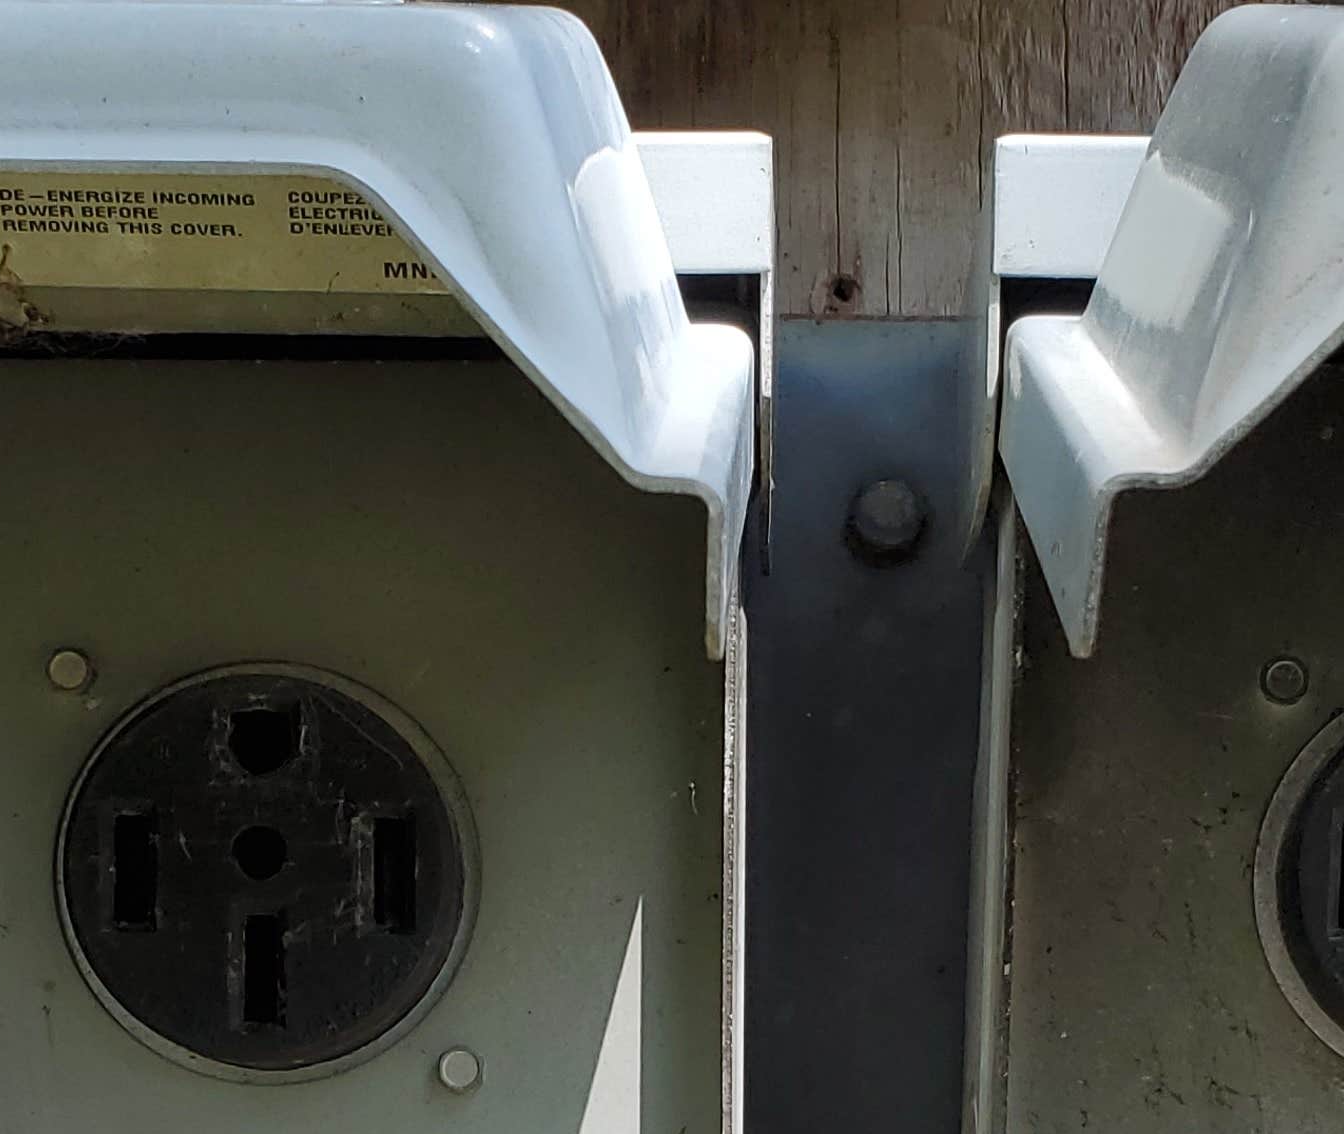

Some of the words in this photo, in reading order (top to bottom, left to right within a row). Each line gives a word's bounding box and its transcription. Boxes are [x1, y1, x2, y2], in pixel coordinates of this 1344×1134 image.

[153, 191, 256, 206] INCOMING
[288, 191, 366, 205] COUPEZ
[0, 204, 74, 218] POWER
[81, 205, 159, 220] BEFORE
[3, 219, 109, 234] REMOVING
[116, 221, 163, 235] THIS
[170, 223, 243, 237] COVER.
